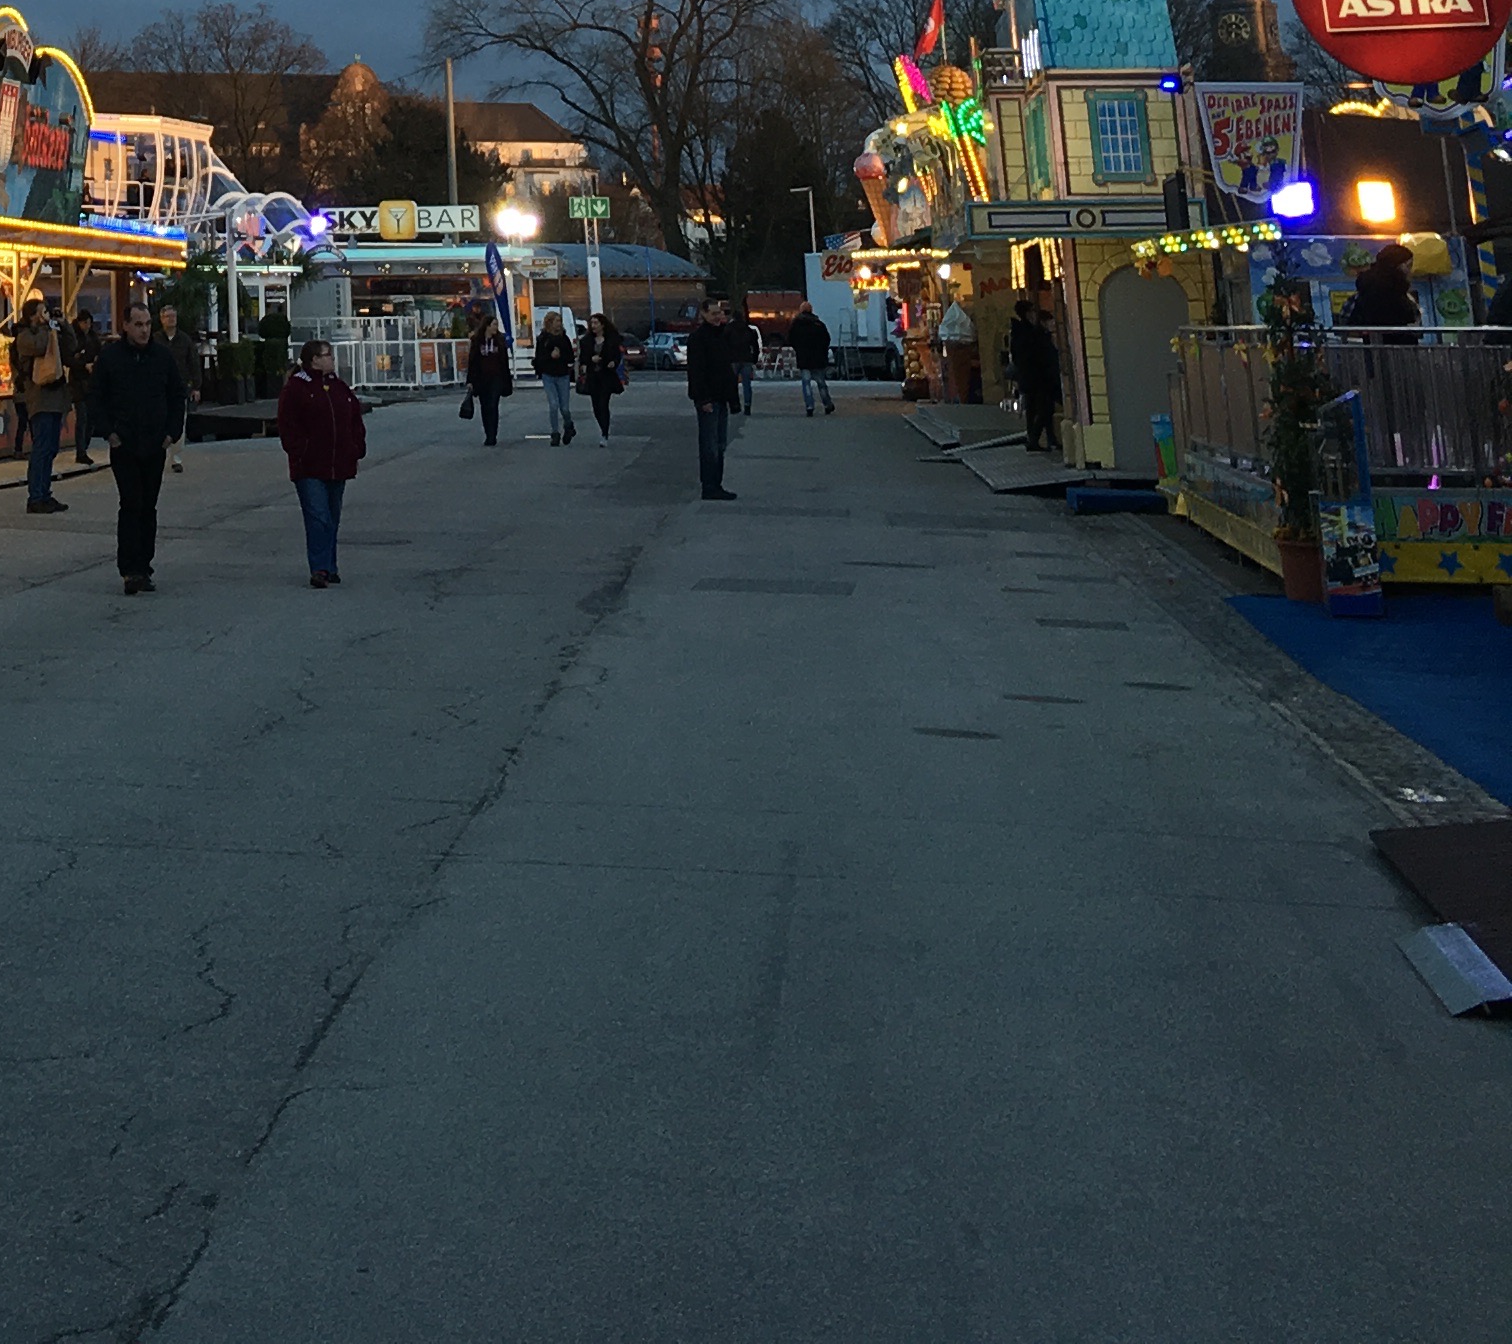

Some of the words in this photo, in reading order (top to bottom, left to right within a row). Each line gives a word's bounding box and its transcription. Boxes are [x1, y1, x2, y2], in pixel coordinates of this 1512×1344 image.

[1208, 94, 1229, 109] DER
[1231, 92, 1258, 114] IRRE
[1213, 116, 1231, 157] 5
[325, 209, 379, 230] SKY
[417, 208, 476, 229] BAR
[821, 254, 853, 280] Eis
[1374, 496, 1483, 539] HAPPY
